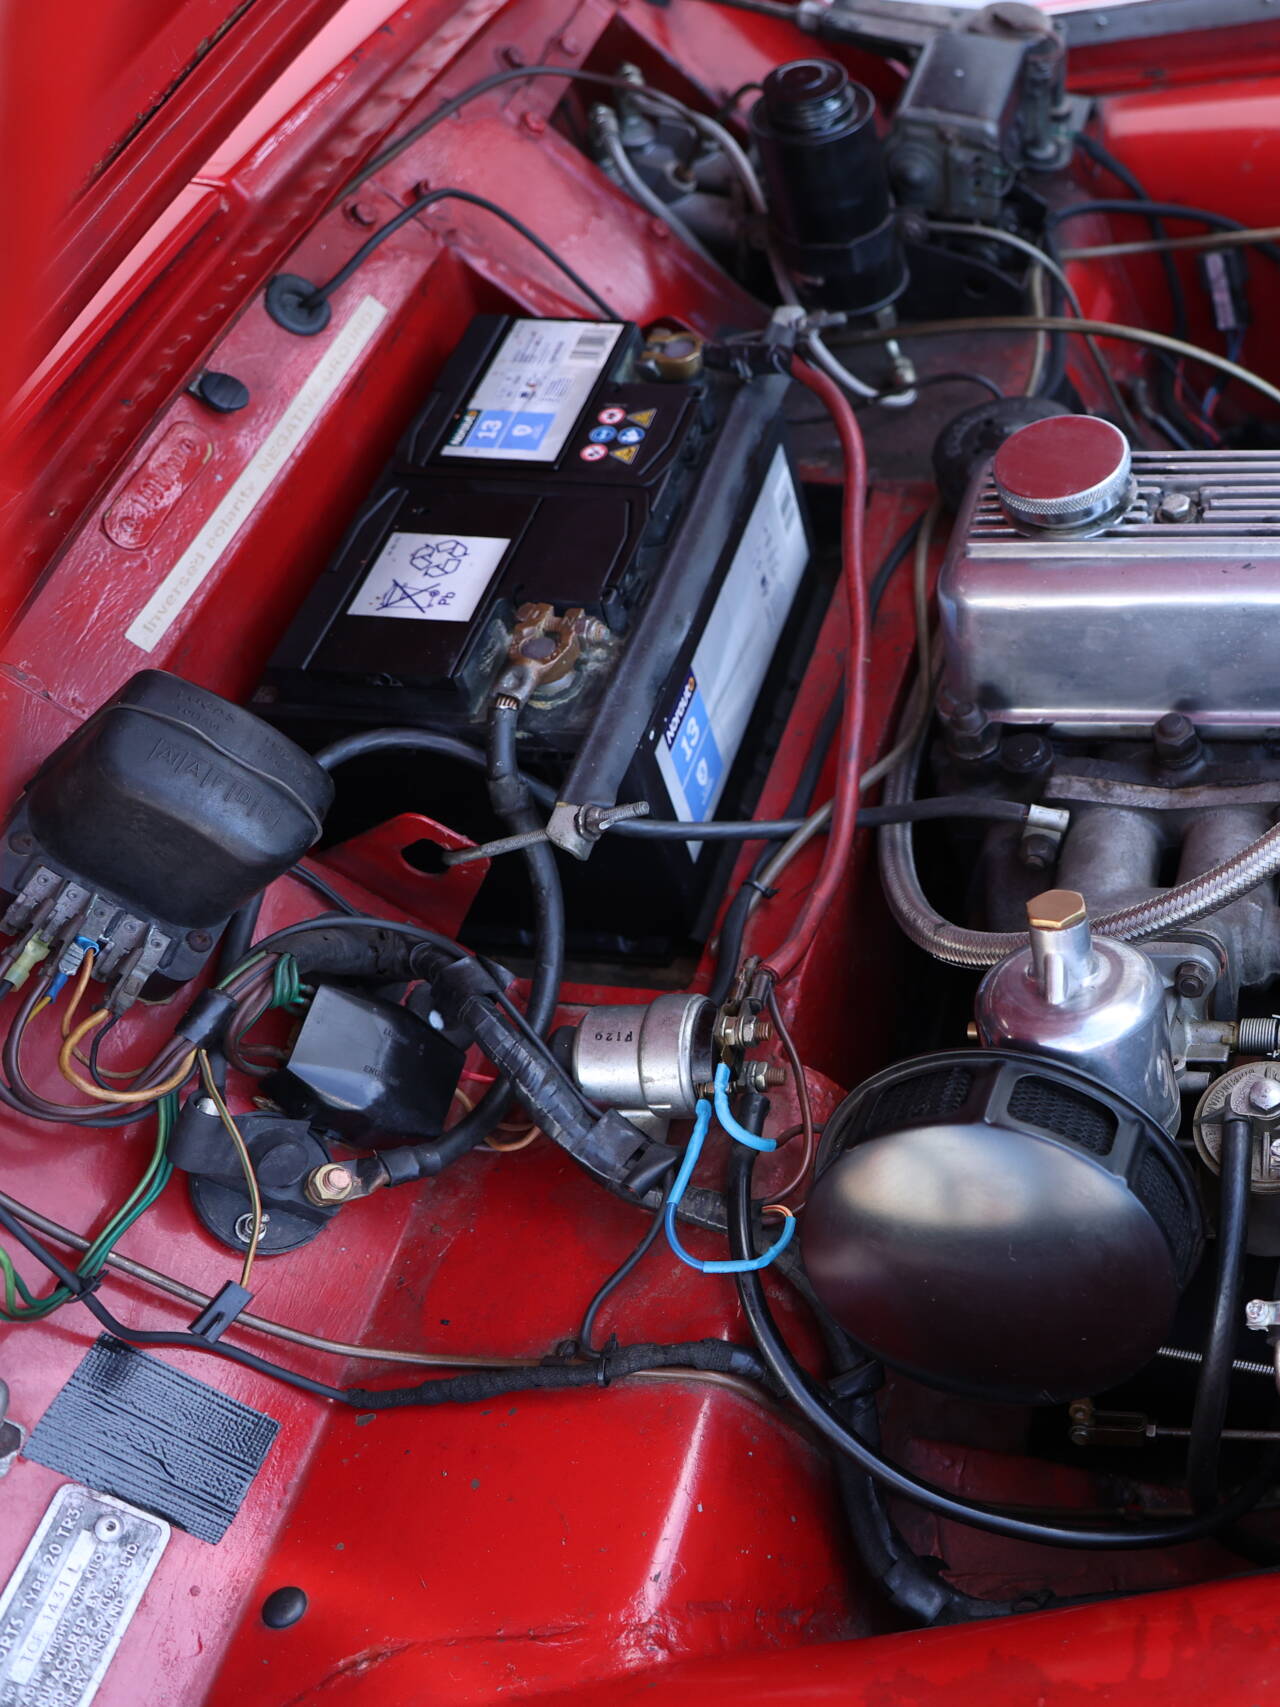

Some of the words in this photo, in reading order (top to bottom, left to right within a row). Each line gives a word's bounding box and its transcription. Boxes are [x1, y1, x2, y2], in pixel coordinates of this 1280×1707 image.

[476, 419, 505, 440] 13
[437, 591, 455, 605] Pb
[681, 715, 703, 762] 13
[22, 1572, 49, 1610] TYPE
[43, 1542, 63, 1566] 20
[42, 1578, 72, 1620] 1431
[68, 1562, 82, 1575] L
[87, 1590, 102, 1611] BY
[41, 1617, 72, 1664] WEIGHT
[86, 1552, 105, 1580] KILO
[88, 1596, 125, 1662] ENGLAND
